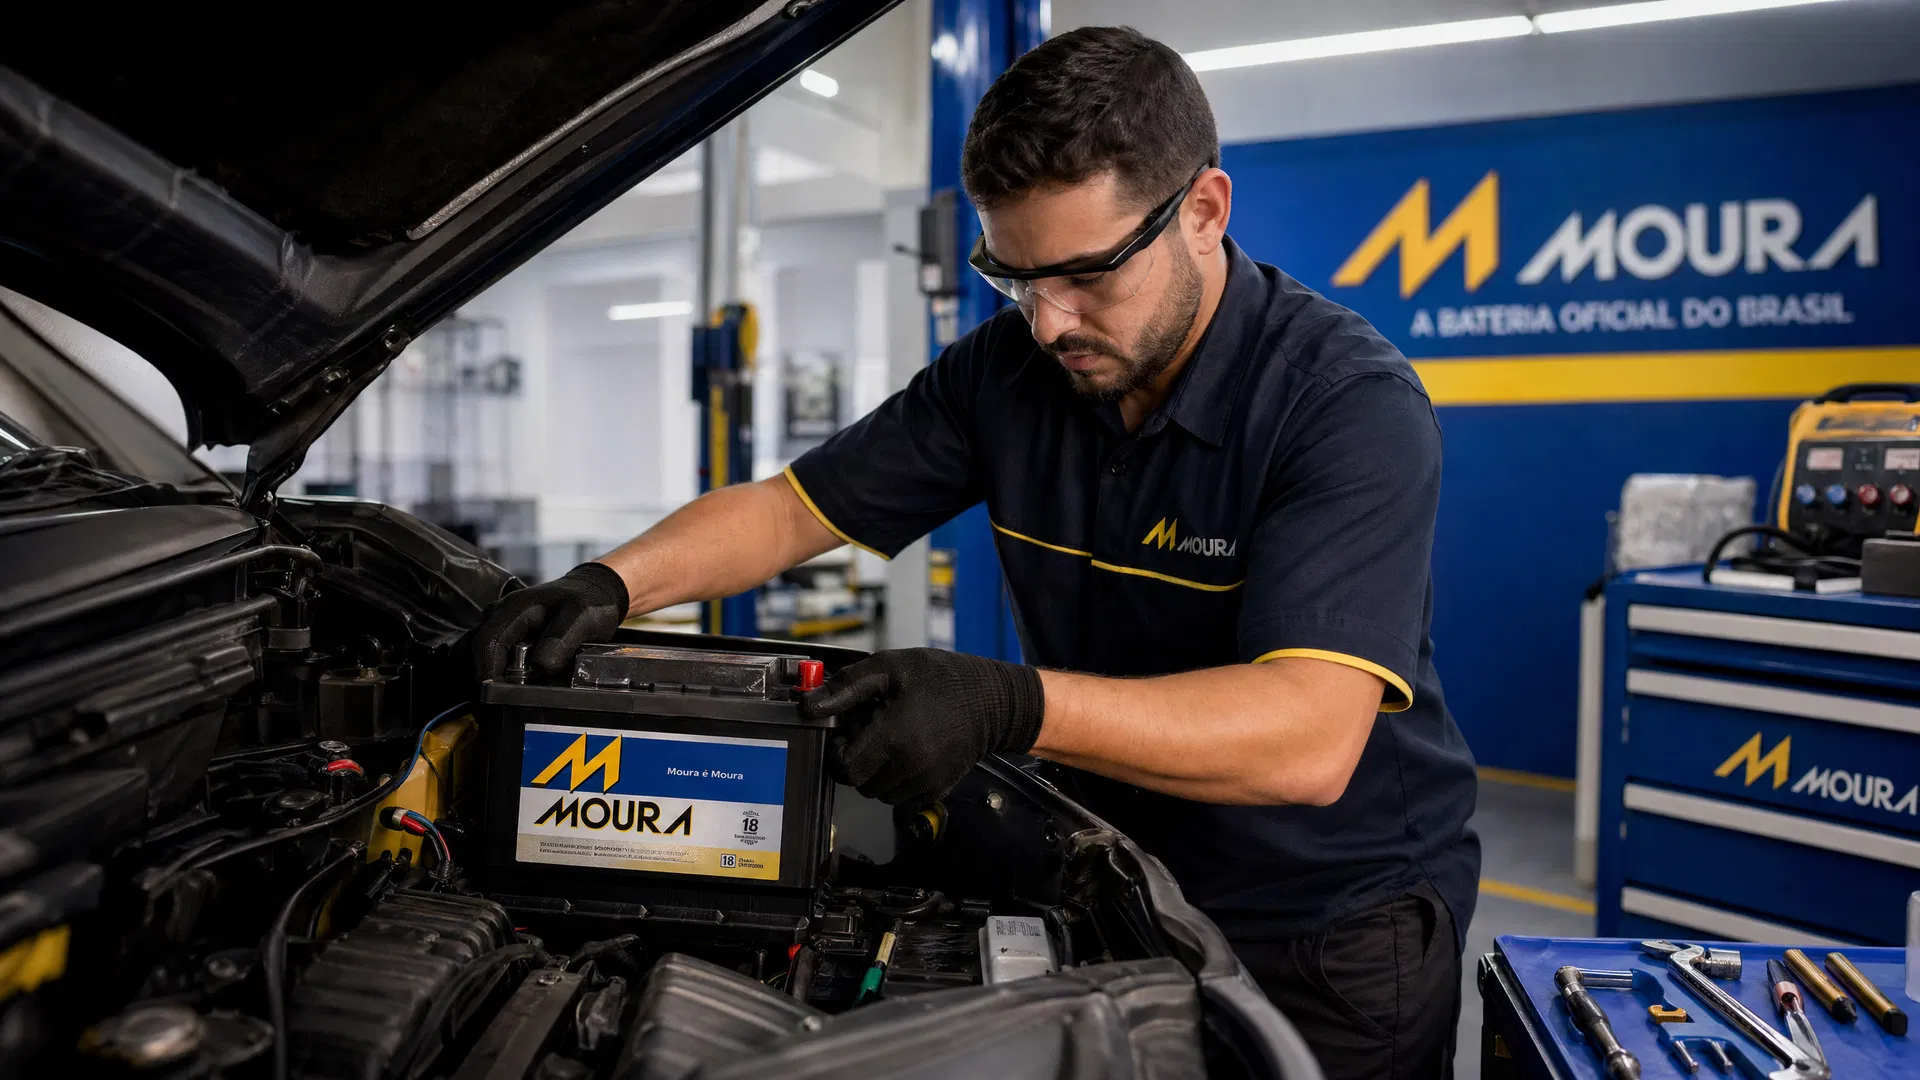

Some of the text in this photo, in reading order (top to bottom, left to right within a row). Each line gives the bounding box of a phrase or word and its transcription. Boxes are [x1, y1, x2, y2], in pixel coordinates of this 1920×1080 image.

[1516, 193, 1880, 285] MOURA
[1409, 291, 1856, 338] A BATERIA OFICIAL DO BRASIL
[1177, 535, 1237, 557] MOURA
[667, 767, 744, 780] Moura é Moura
[1791, 765, 1920, 816] MOURA
[533, 795, 693, 837] MOURA
[742, 817, 759, 832] 18
[722, 855, 735, 867] 18
